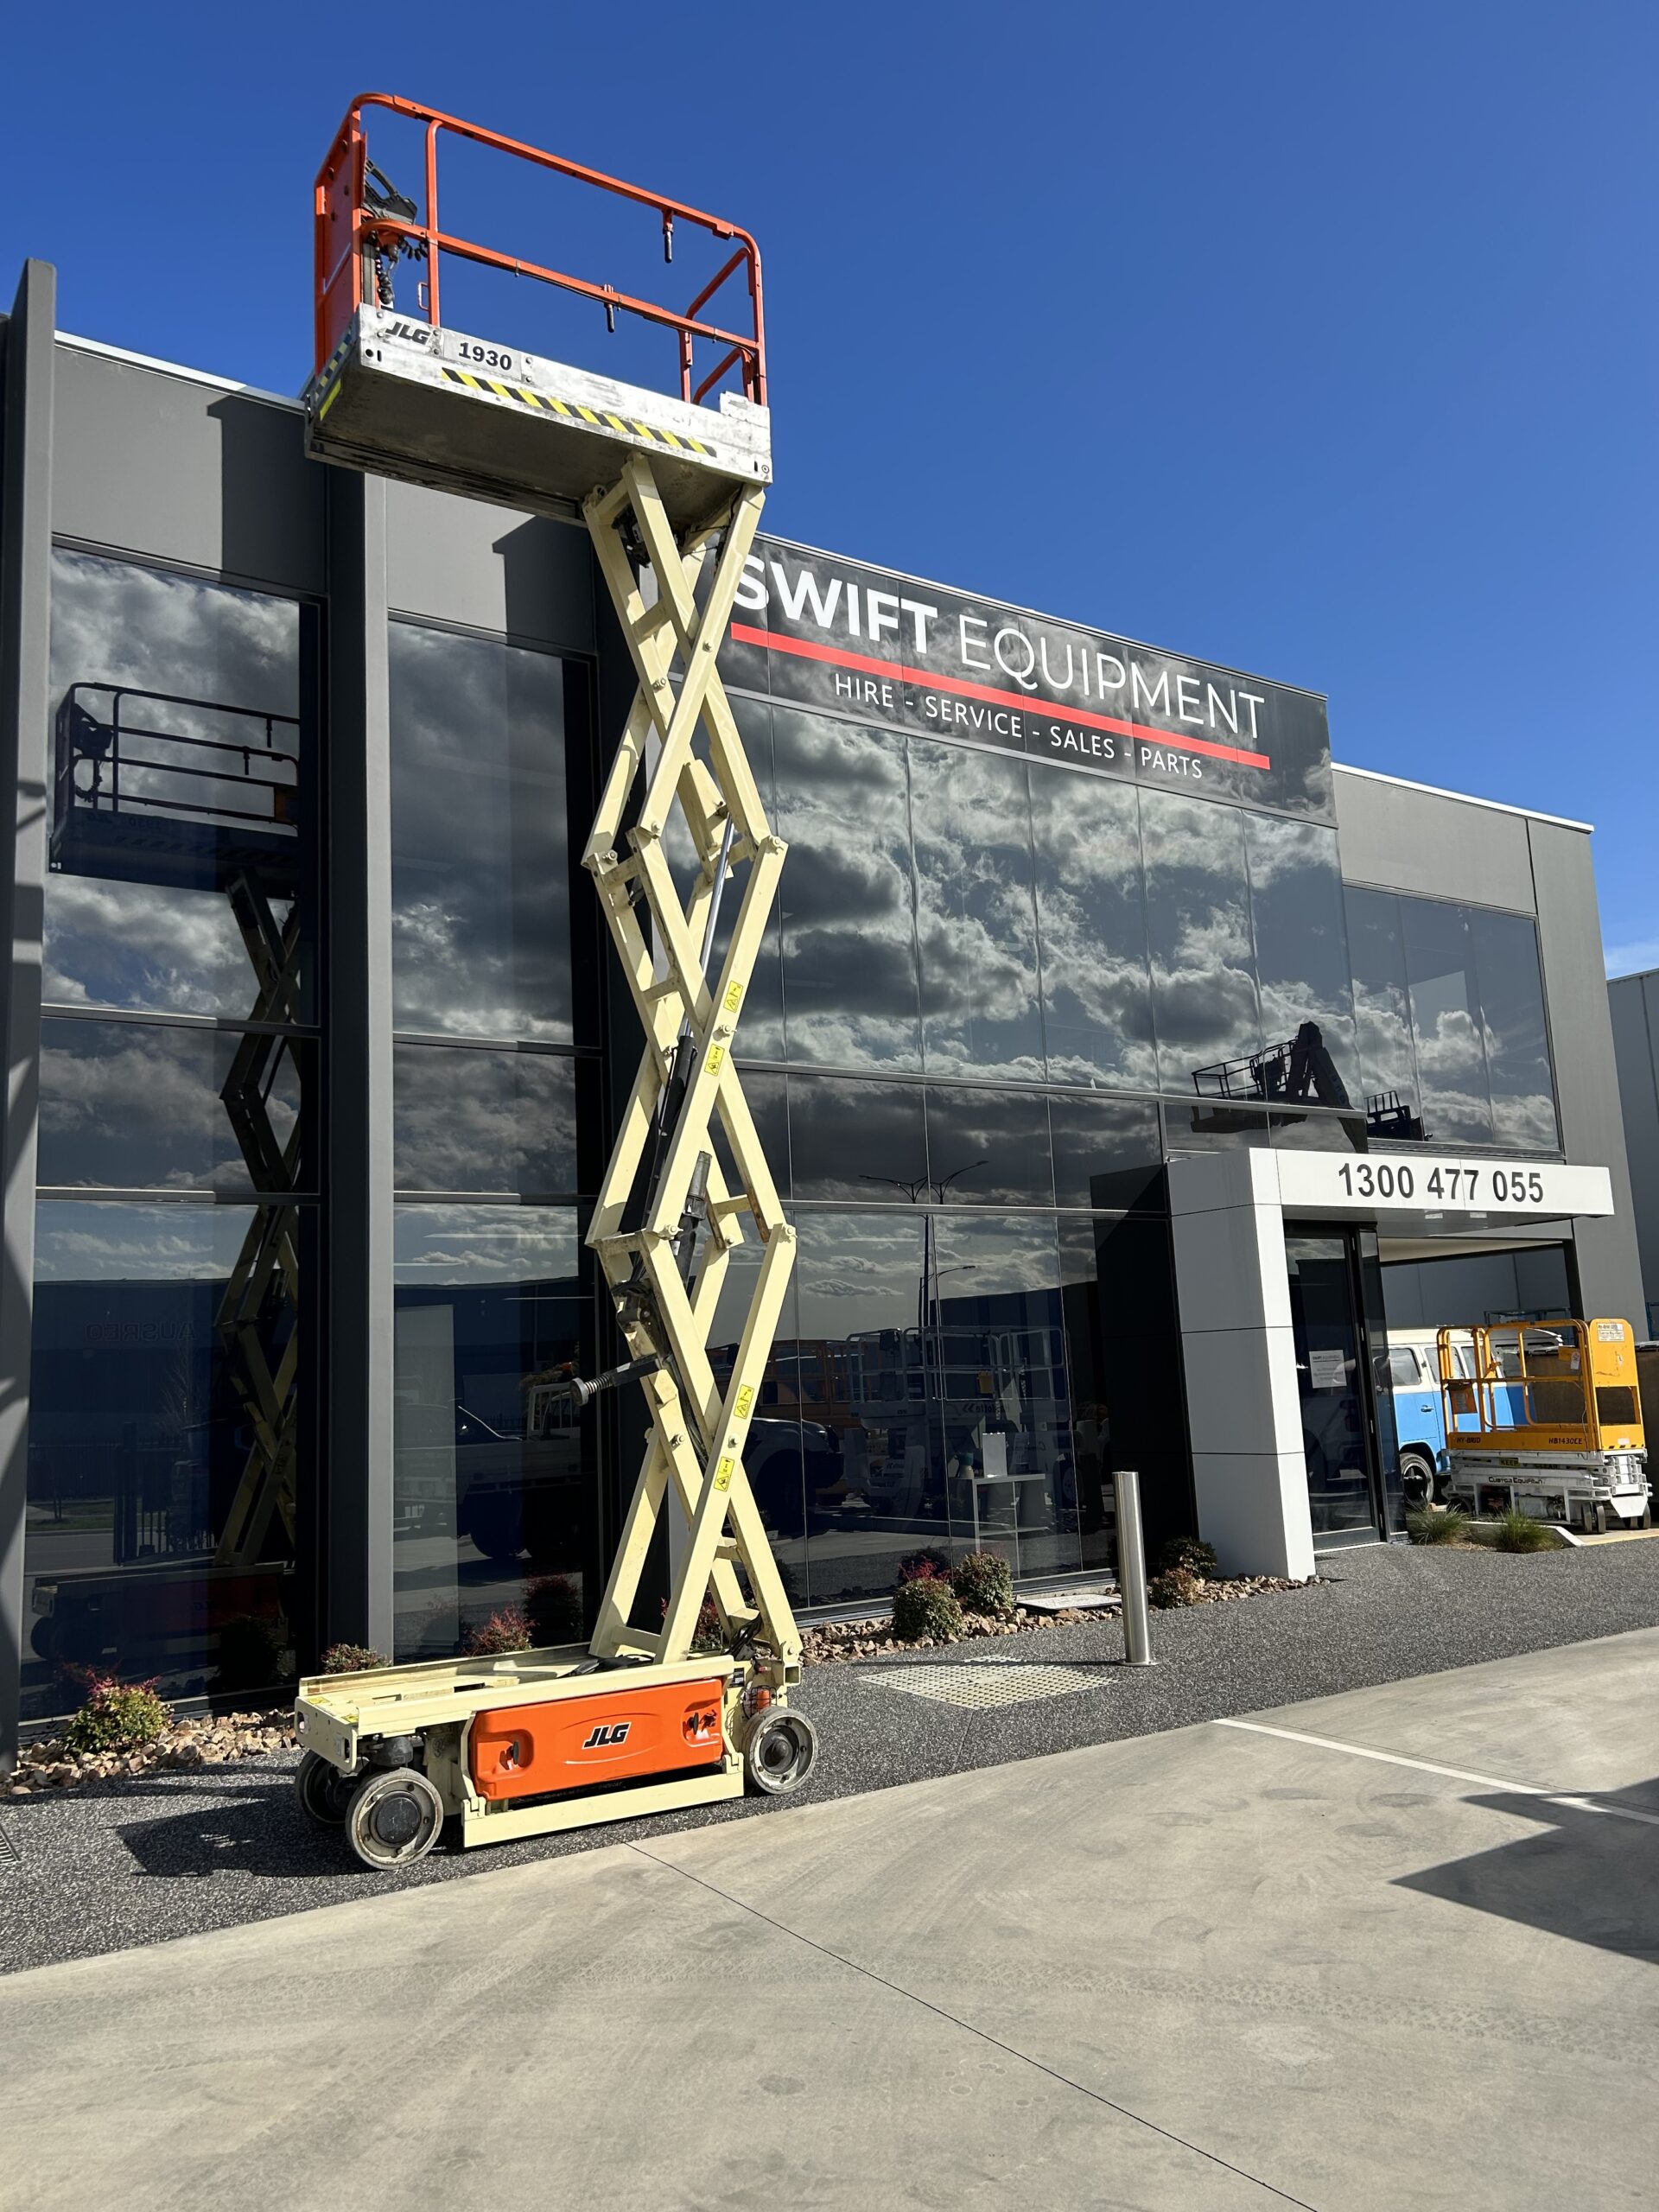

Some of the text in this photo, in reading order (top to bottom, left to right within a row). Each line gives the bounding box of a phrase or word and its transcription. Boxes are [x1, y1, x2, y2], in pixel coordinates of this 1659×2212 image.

[385, 321, 430, 345] JLG
[458, 342, 512, 371] 1930
[734, 554, 1265, 739] SWIFT EQUIPMENT
[836, 673, 894, 709] HIRE
[925, 696, 1022, 738] SERVICE
[1050, 725, 1116, 759] SALES
[1141, 747, 1203, 779] PARTS
[1338, 1162, 1544, 1203] 1300 477 055
[582, 1722, 632, 1749] JLG
